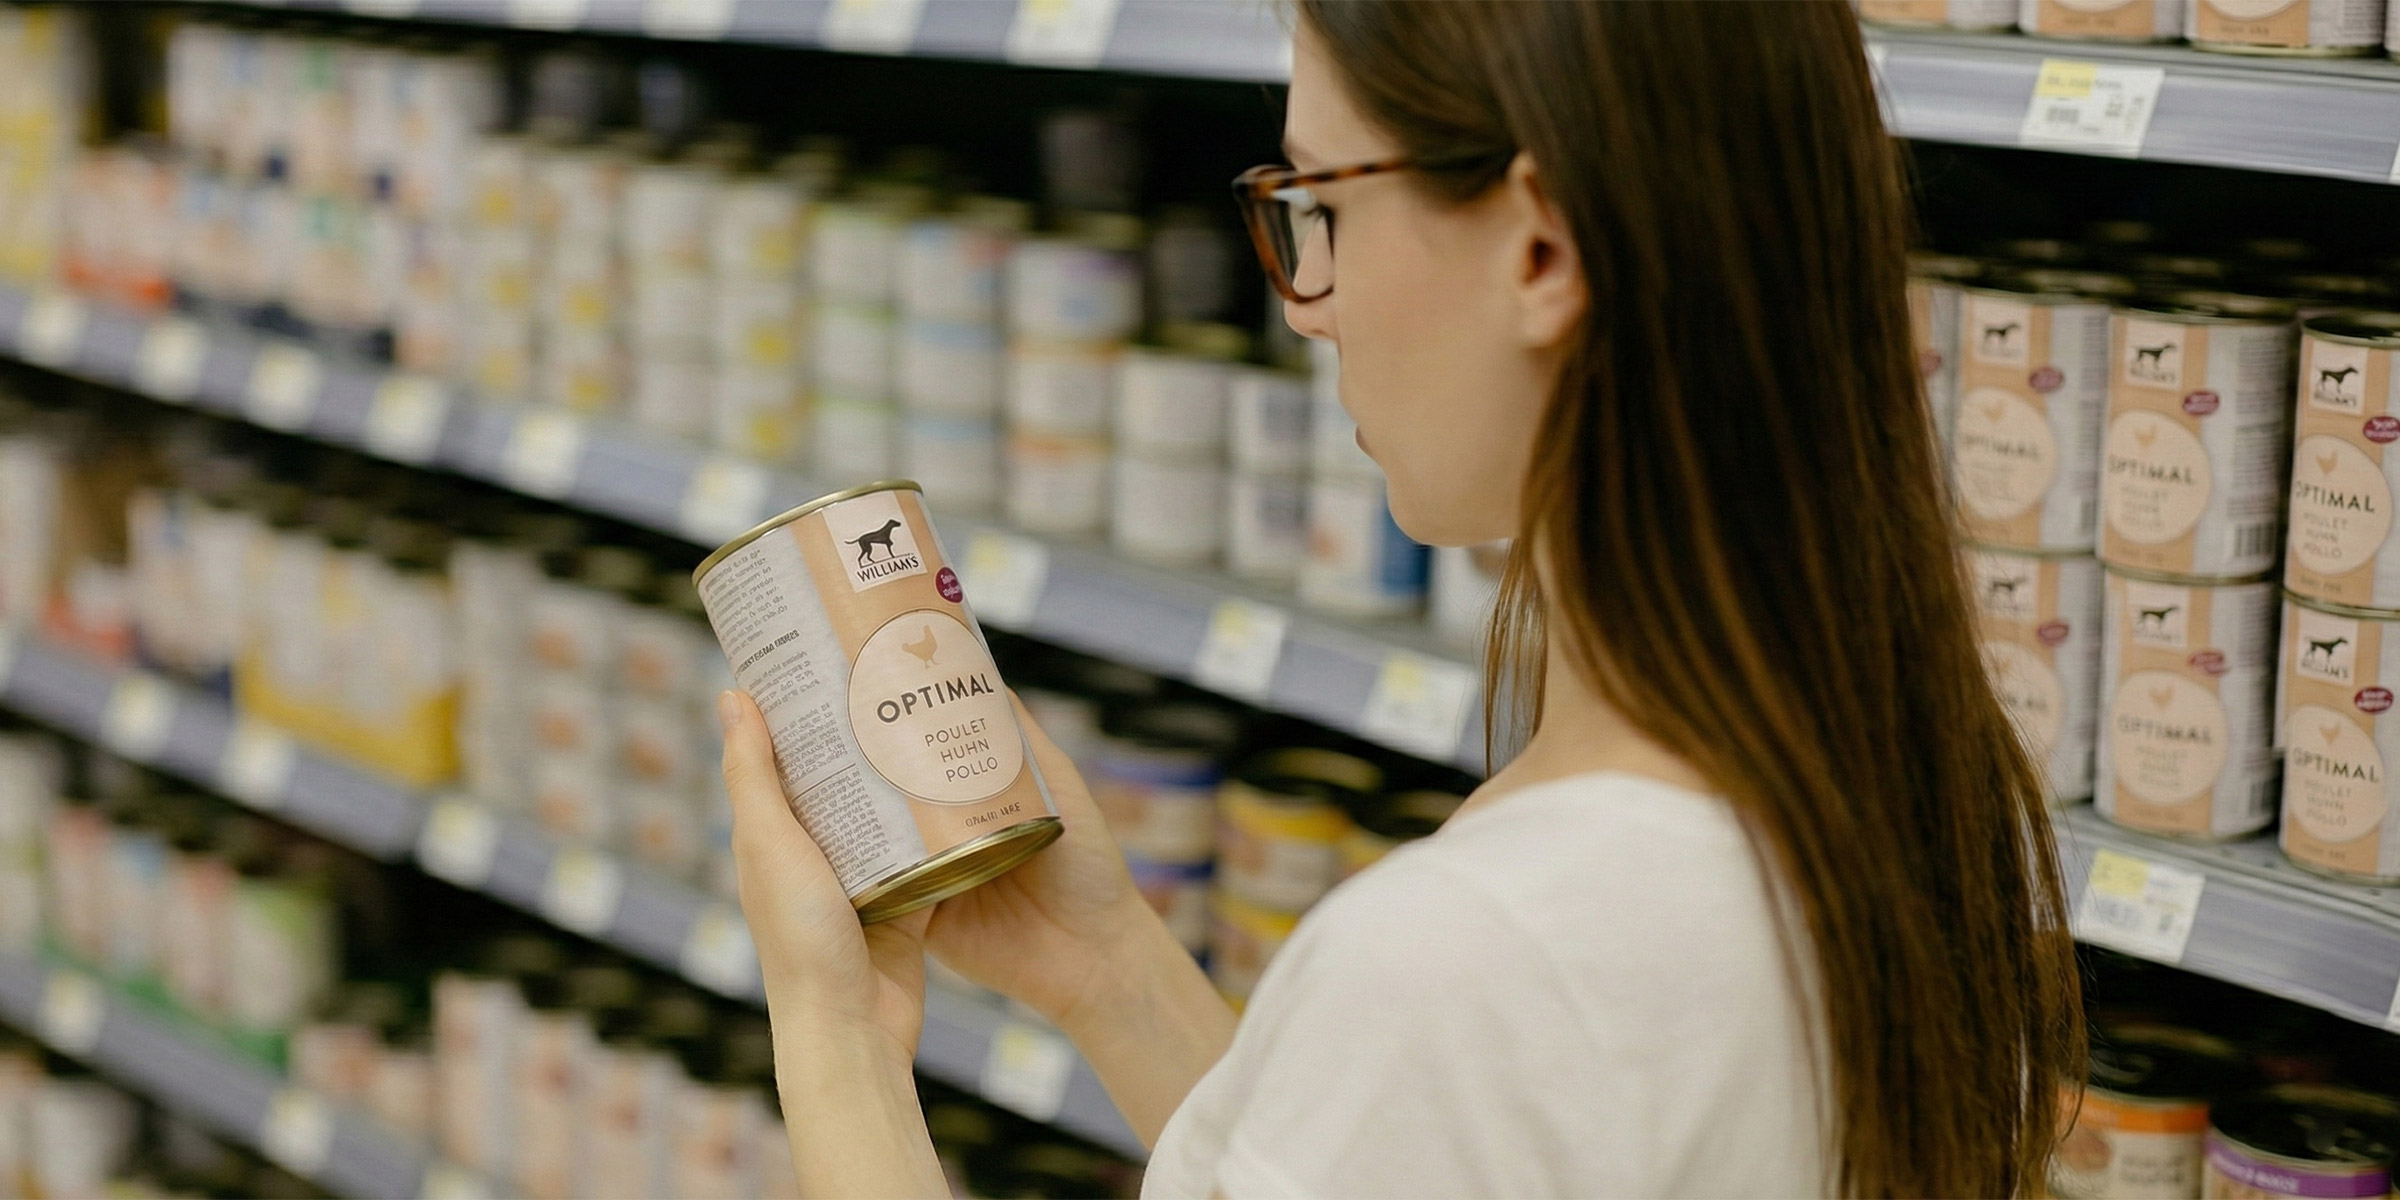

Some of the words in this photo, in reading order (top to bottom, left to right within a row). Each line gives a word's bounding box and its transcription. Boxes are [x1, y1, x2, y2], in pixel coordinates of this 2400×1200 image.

[857, 556, 919, 582] WILLIAM'S
[877, 673, 994, 723] OPTIMAL
[924, 718, 987, 747] POULET
[940, 738, 990, 763] HUHN
[945, 756, 998, 782] POLLO
